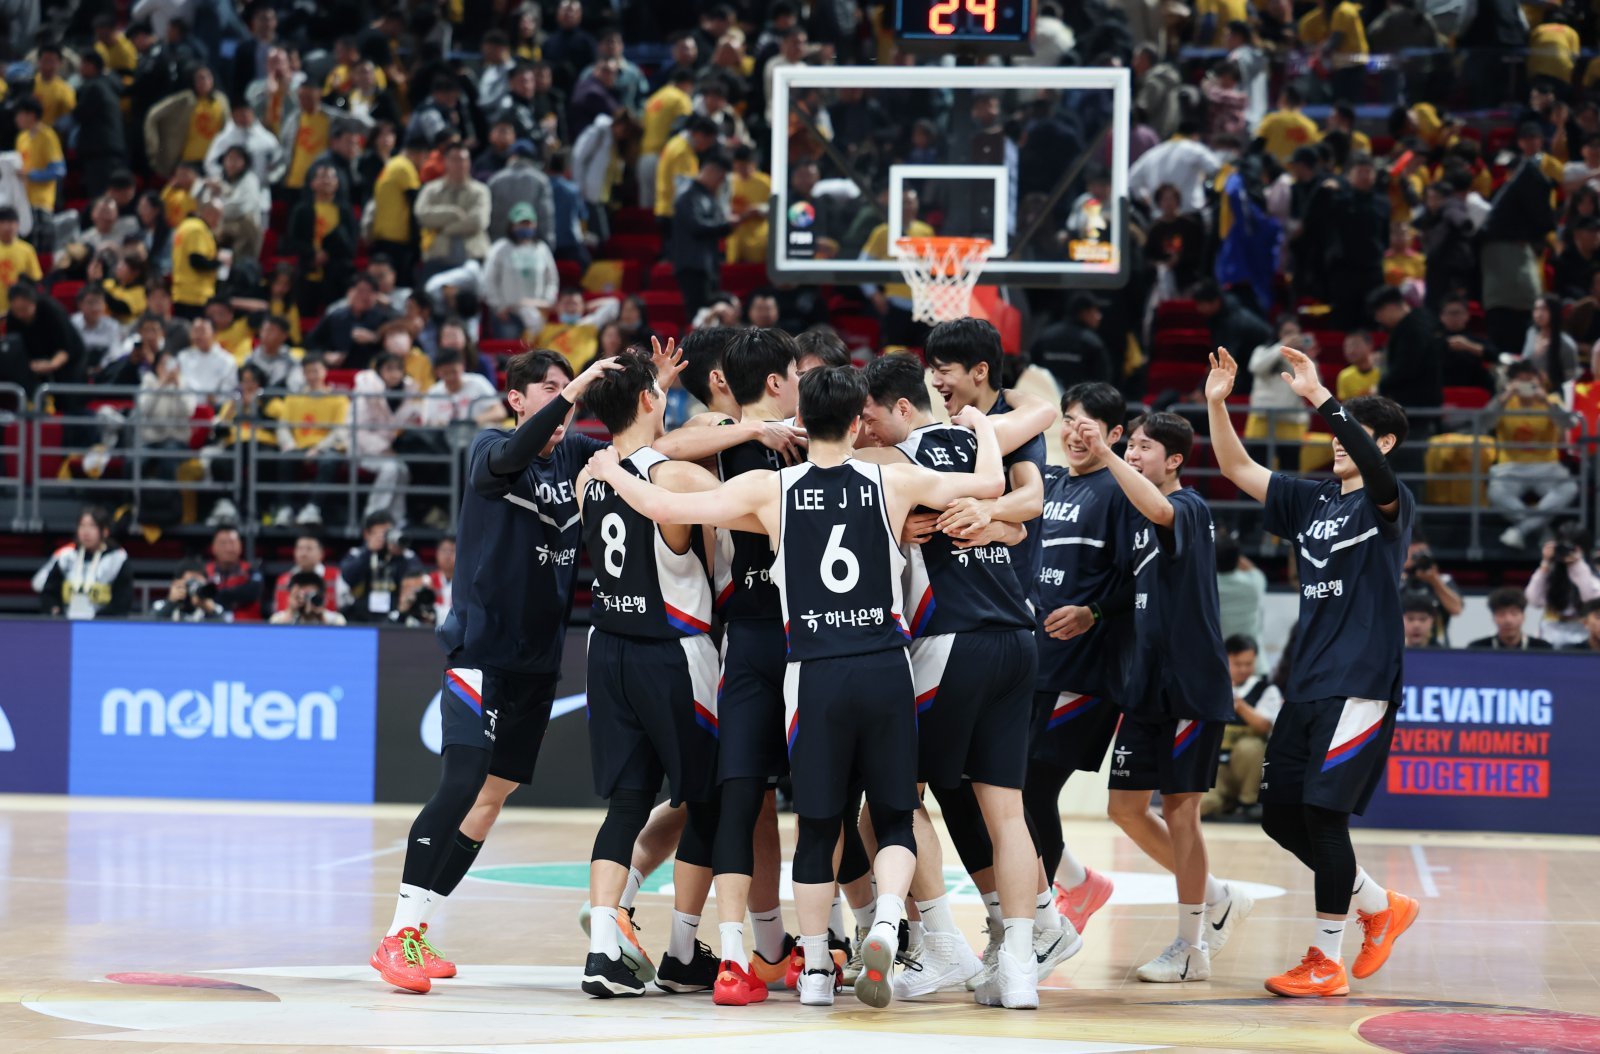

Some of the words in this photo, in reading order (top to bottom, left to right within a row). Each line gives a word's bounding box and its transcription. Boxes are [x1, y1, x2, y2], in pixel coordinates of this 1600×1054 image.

[928, 0, 996, 35] 24
[924, 446, 954, 466] LEE
[955, 445, 969, 463] S
[794, 488, 824, 511] LEE
[838, 487, 848, 509] J
[860, 484, 873, 507] H
[1042, 500, 1081, 523] OREA
[600, 511, 627, 579] 8
[819, 523, 861, 594] 6
[1039, 566, 1066, 586] 은행
[607, 594, 647, 614] 나은행
[824, 607, 885, 629] 하나은행
[101, 680, 338, 741] molten
[1390, 728, 1453, 754] EVERY
[1459, 729, 1550, 756] MOMENT
[1397, 759, 1541, 794] TOGETHER
